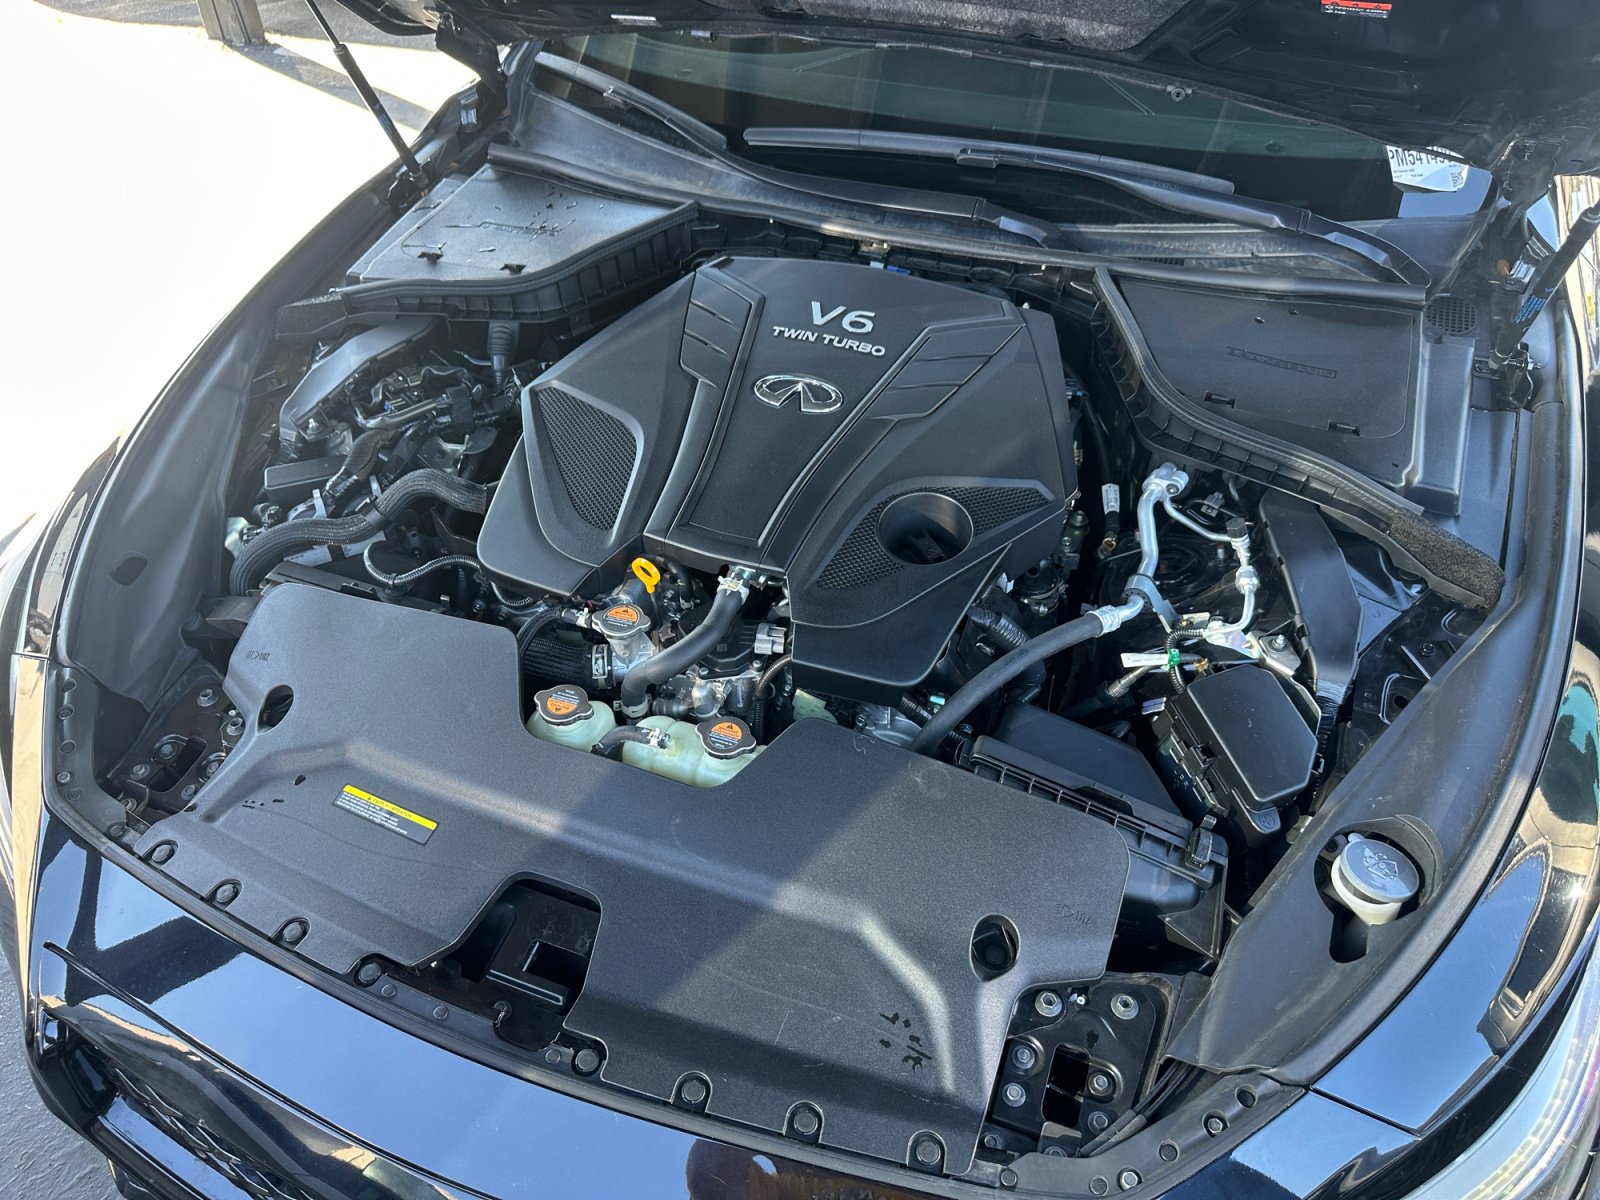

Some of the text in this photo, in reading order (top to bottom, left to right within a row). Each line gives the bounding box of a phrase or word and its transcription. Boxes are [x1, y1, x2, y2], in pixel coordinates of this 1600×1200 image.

[811, 300, 876, 334] V6
[772, 326, 886, 356] TWIN TURBO
